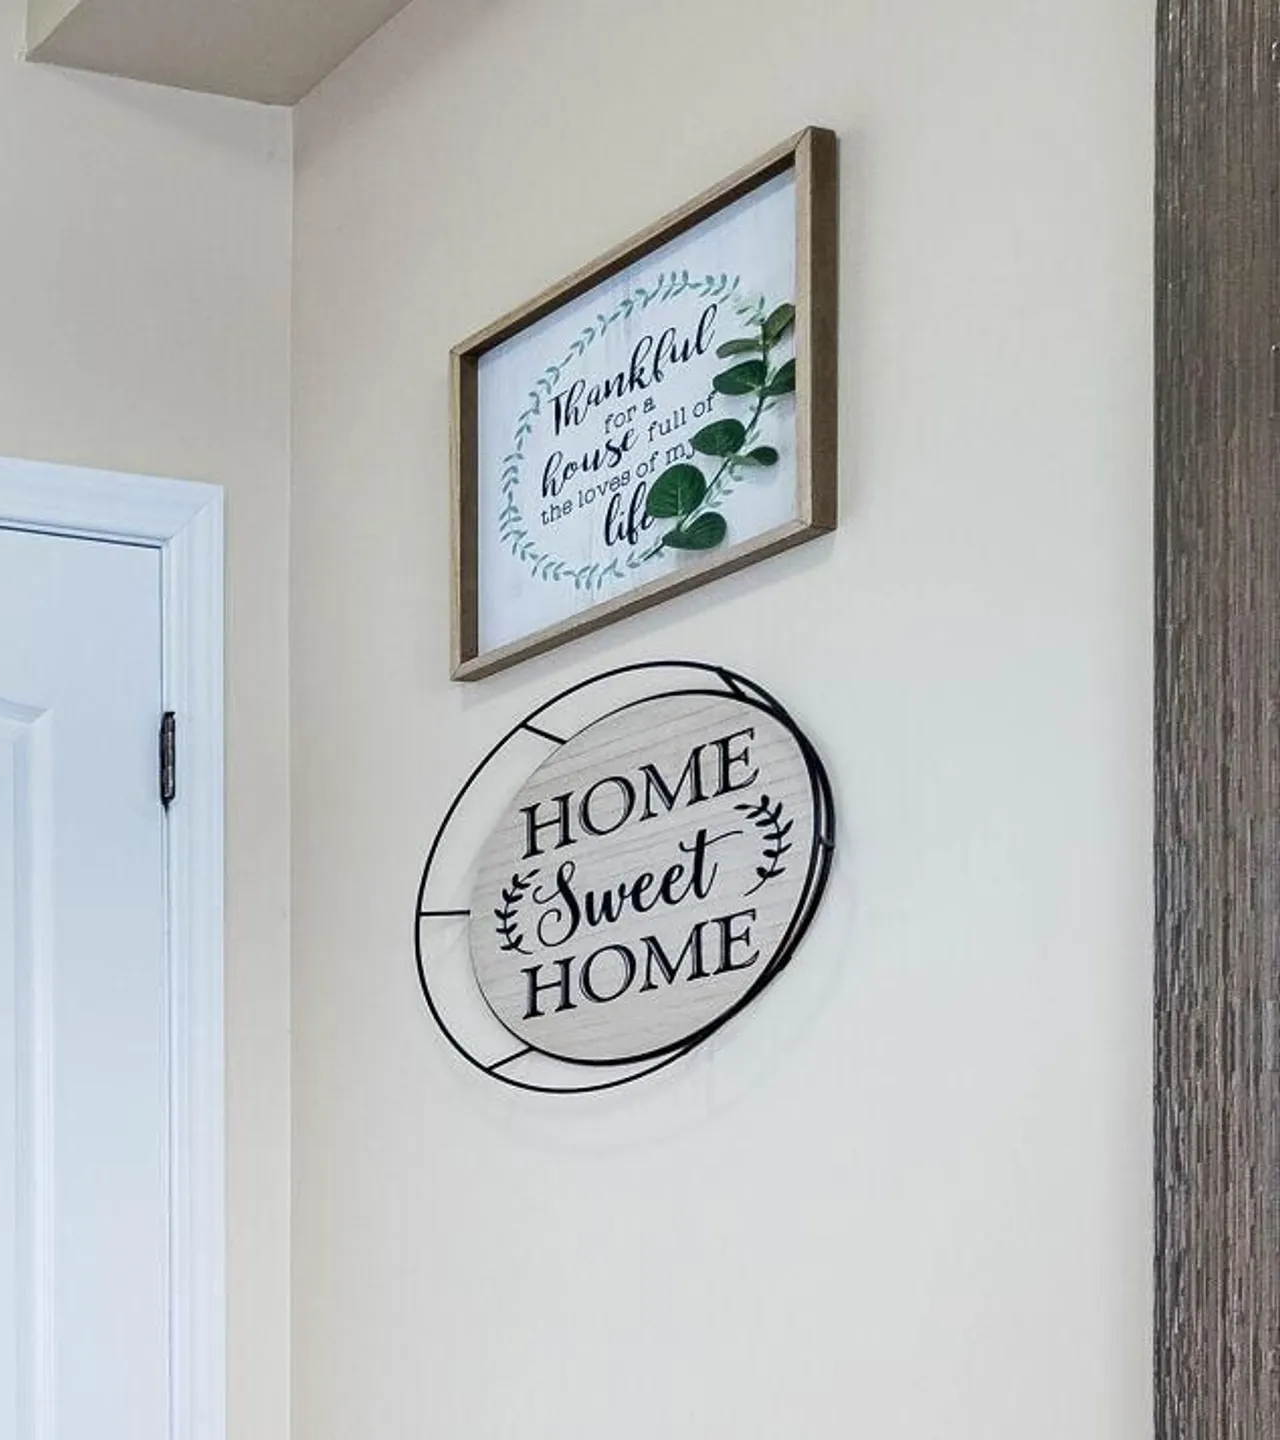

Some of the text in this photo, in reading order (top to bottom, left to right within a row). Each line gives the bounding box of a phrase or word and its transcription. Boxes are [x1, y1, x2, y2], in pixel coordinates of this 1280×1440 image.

[547, 303, 717, 436] Thankful
[604, 397, 656, 434] for a
[540, 499, 573, 526] the
[578, 470, 631, 509] loves
[635, 450, 659, 478] of
[542, 391, 717, 498] house full of
[520, 727, 760, 860] HOME
[531, 828, 744, 947] Sweet
[520, 908, 760, 1021] HOME
